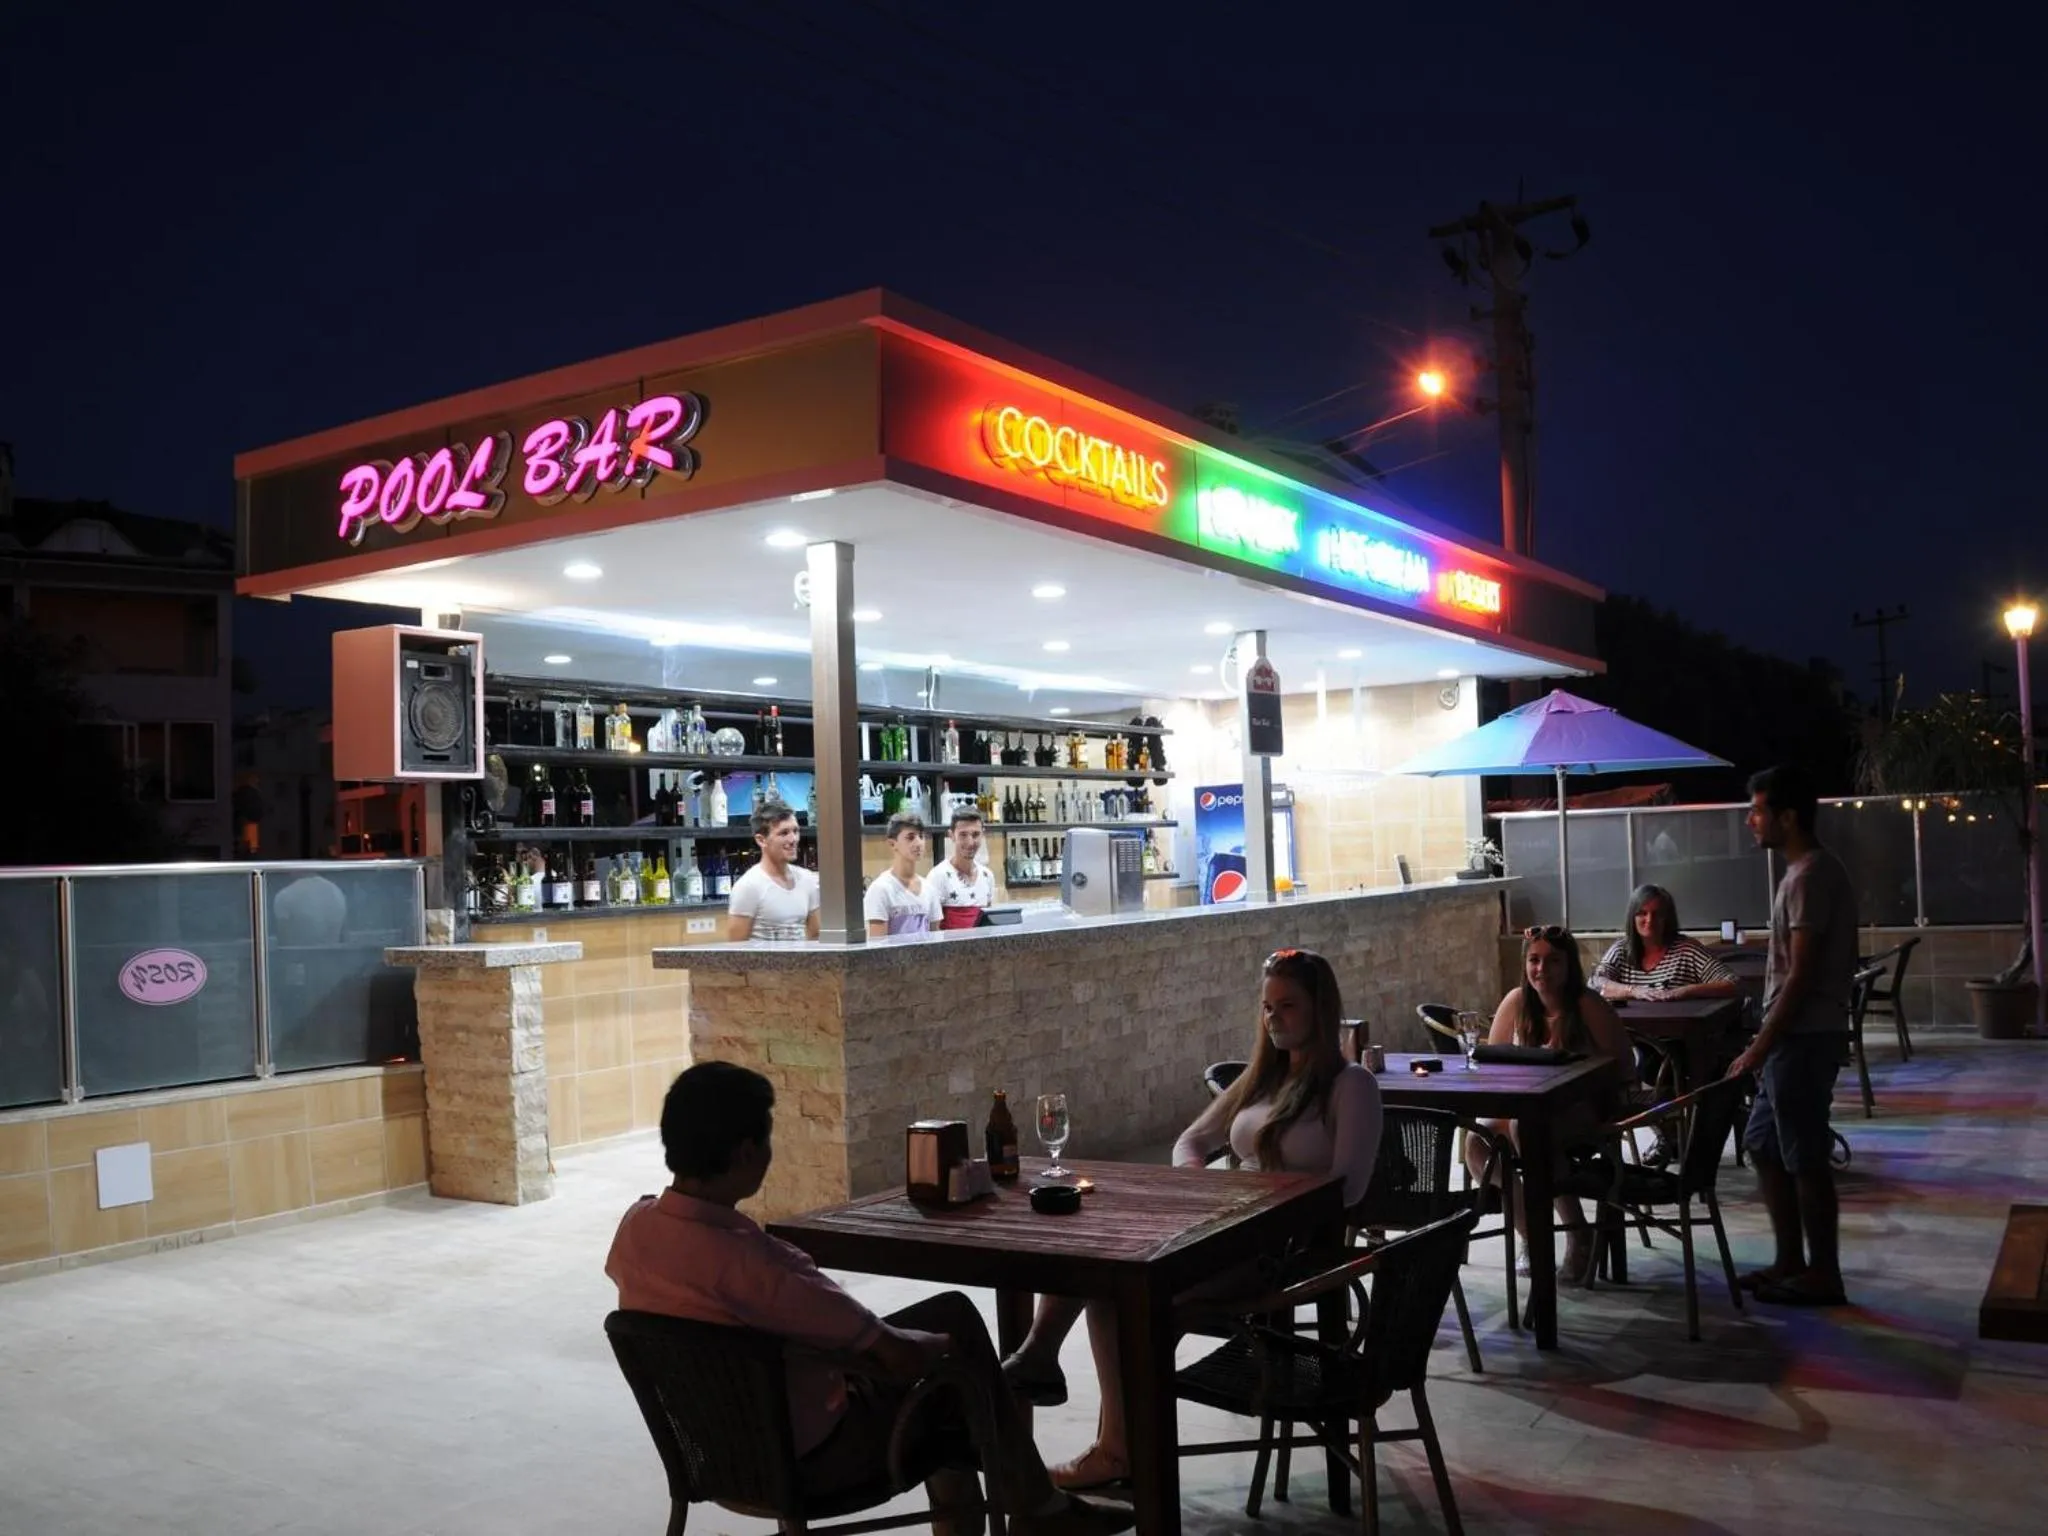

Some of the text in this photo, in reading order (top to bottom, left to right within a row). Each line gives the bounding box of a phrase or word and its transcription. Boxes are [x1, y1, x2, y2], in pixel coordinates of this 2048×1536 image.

[338, 394, 684, 540] POOL BAR
[998, 406, 1169, 506] COCKTAILS
[1218, 795, 1243, 807] pep
